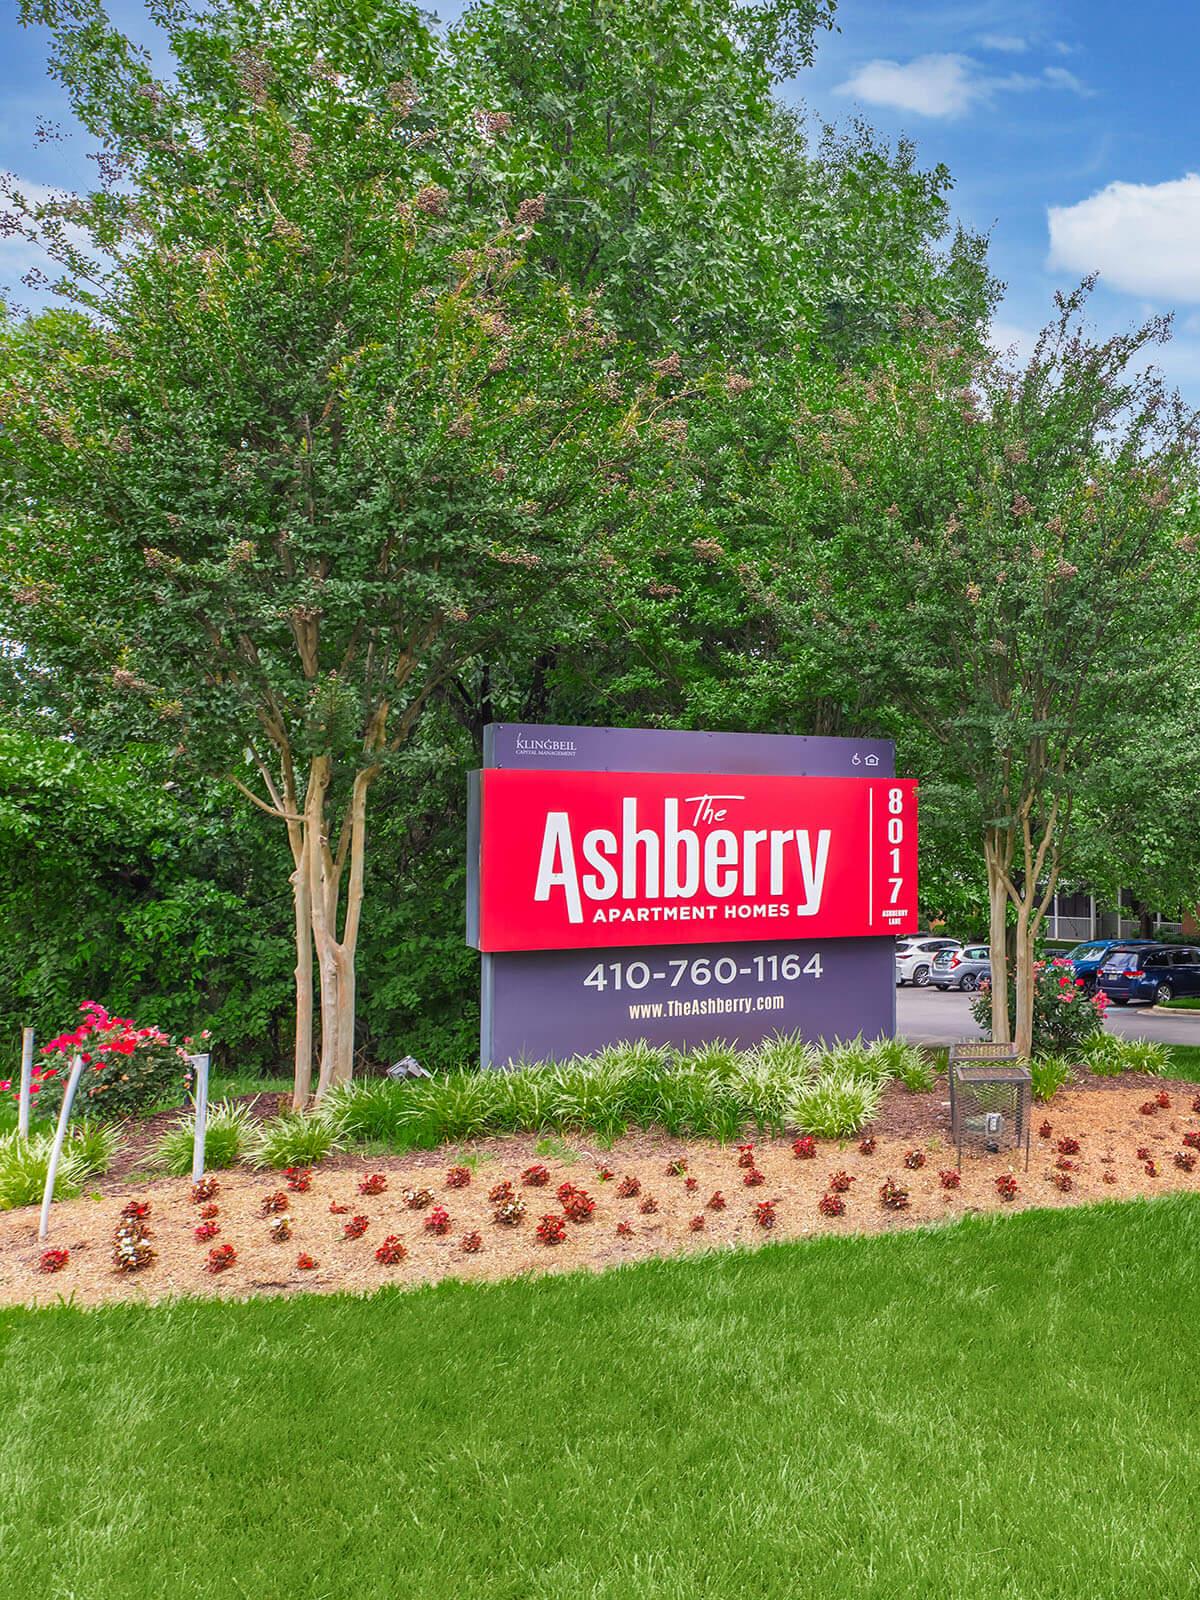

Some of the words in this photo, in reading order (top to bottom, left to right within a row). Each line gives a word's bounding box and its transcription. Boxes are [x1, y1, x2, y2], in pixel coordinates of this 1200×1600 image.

[515, 732, 577, 751] KLINGBEIL
[685, 794, 745, 827] The
[534, 797, 832, 924] Ashberry
[593, 906, 717, 923] APARTMENT
[724, 903, 790, 919] HOMES
[888, 917, 902, 926] LANE
[583, 953, 824, 992] 410-760-1164
[628, 995, 785, 1020] www.TheAshberry.com
